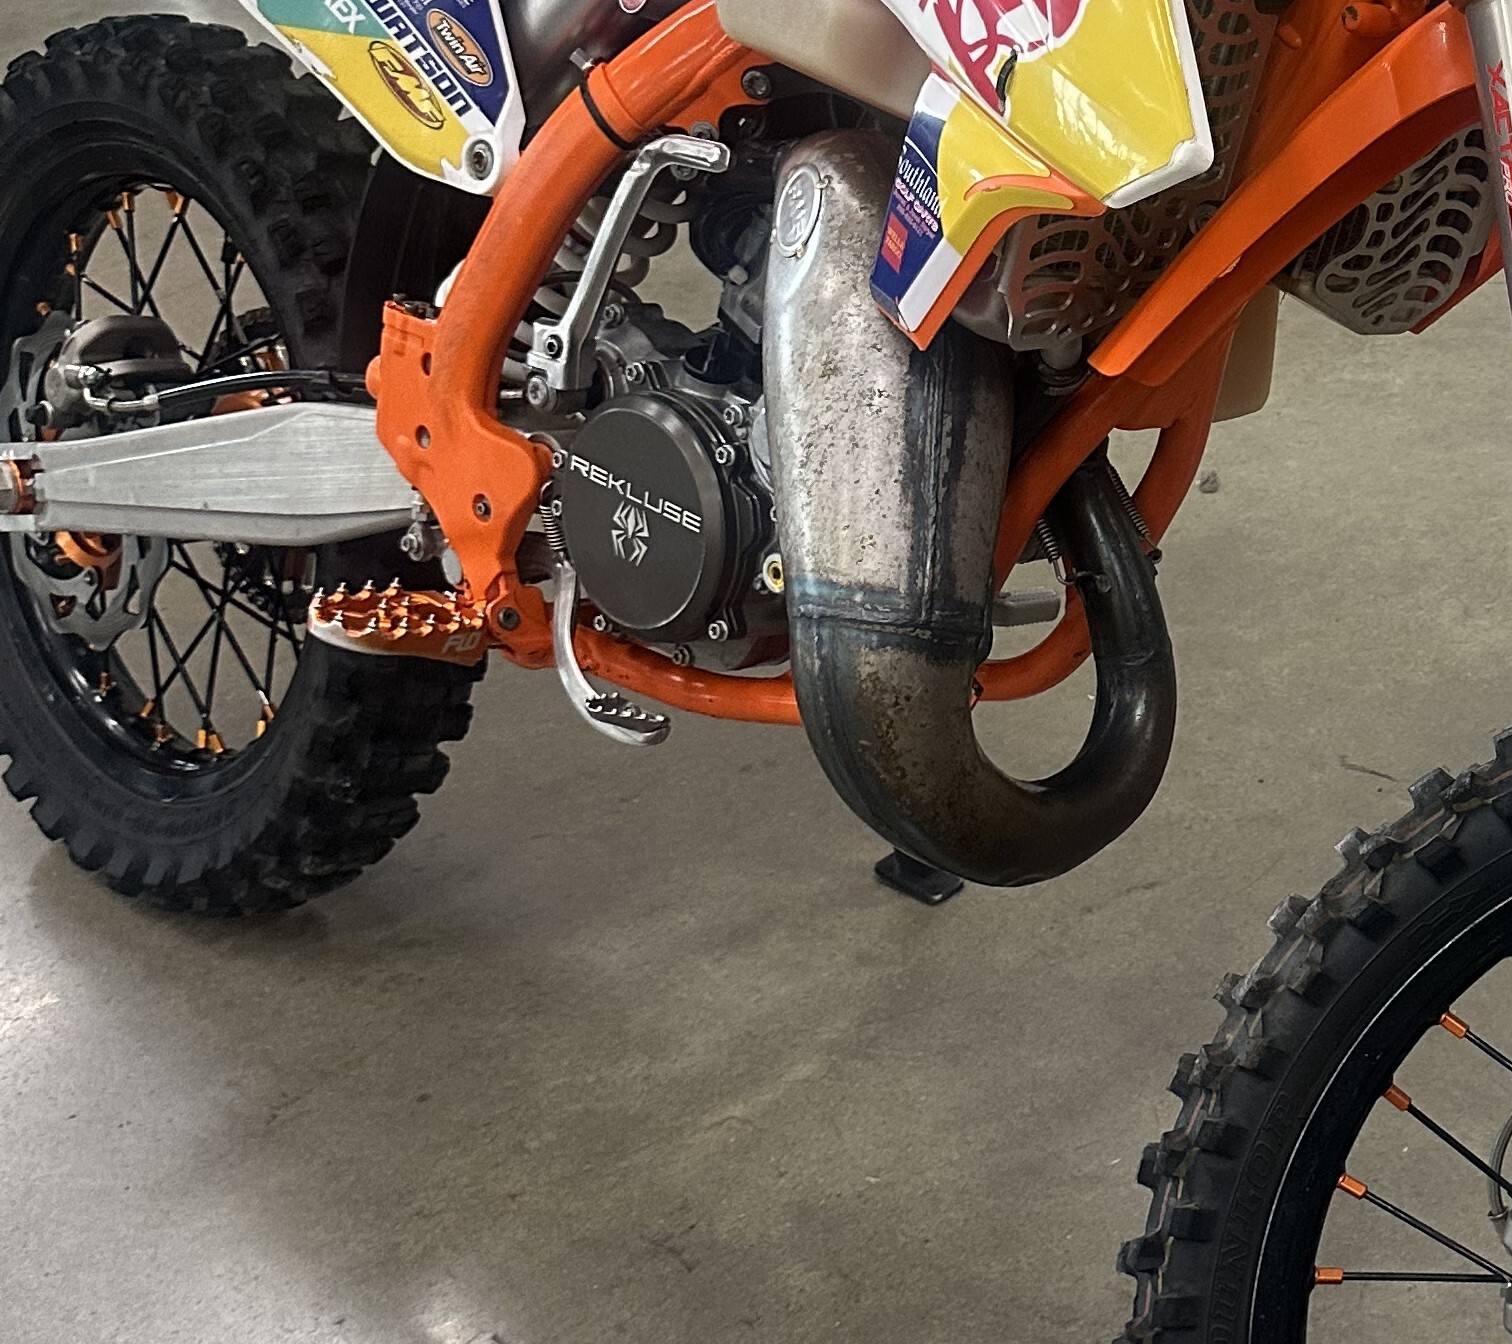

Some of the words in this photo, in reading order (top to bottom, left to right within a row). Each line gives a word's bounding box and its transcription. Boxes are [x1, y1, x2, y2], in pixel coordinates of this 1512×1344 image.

[369, 43, 445, 123] FMF
[433, 17, 466, 60] Twin
[457, 48, 490, 77] Air
[570, 456, 701, 533] REKLUSE
